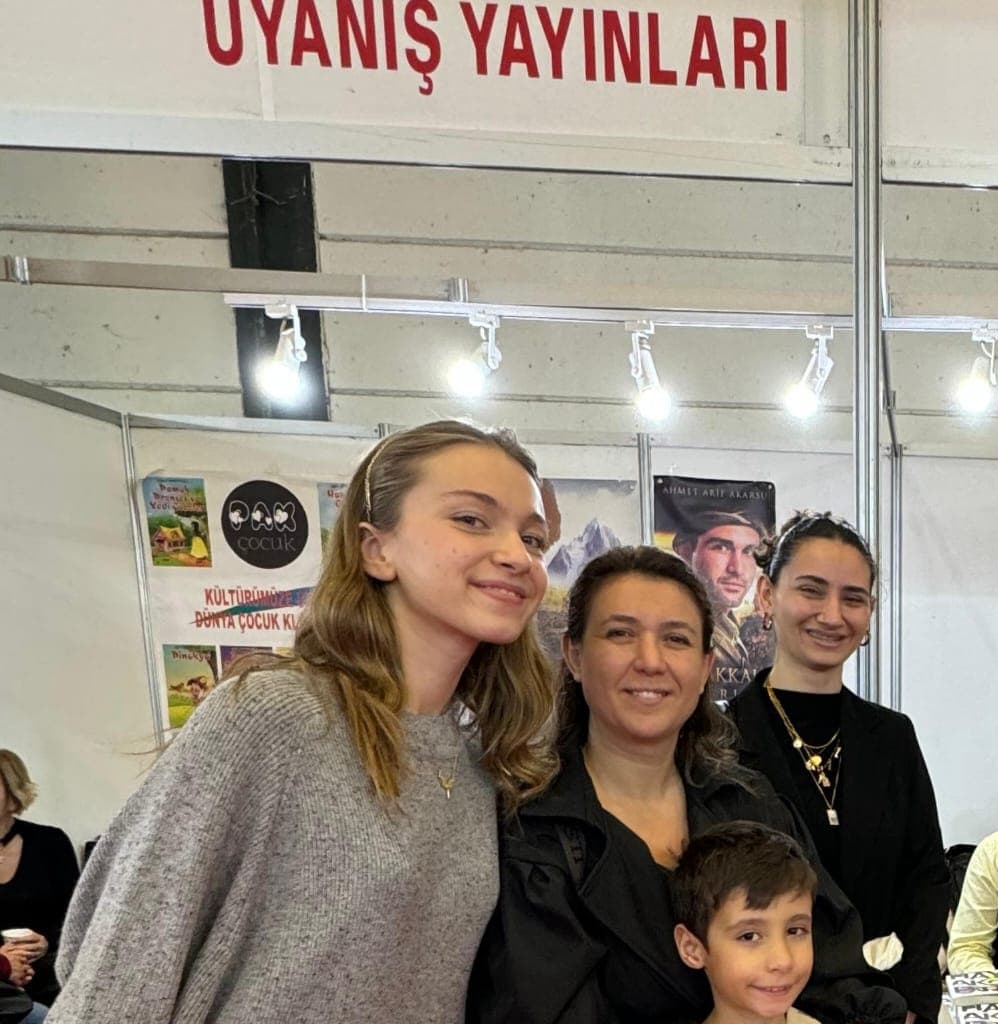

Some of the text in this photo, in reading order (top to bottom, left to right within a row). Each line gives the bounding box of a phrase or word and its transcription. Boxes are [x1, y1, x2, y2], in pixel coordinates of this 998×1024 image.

[203, 0, 788, 96] UYANIŞ YAYINLARI
[663, 486, 698, 496] AHMET
[195, 608, 235, 629] DÜNYA
[237, 611, 280, 633] ÇOCUK
